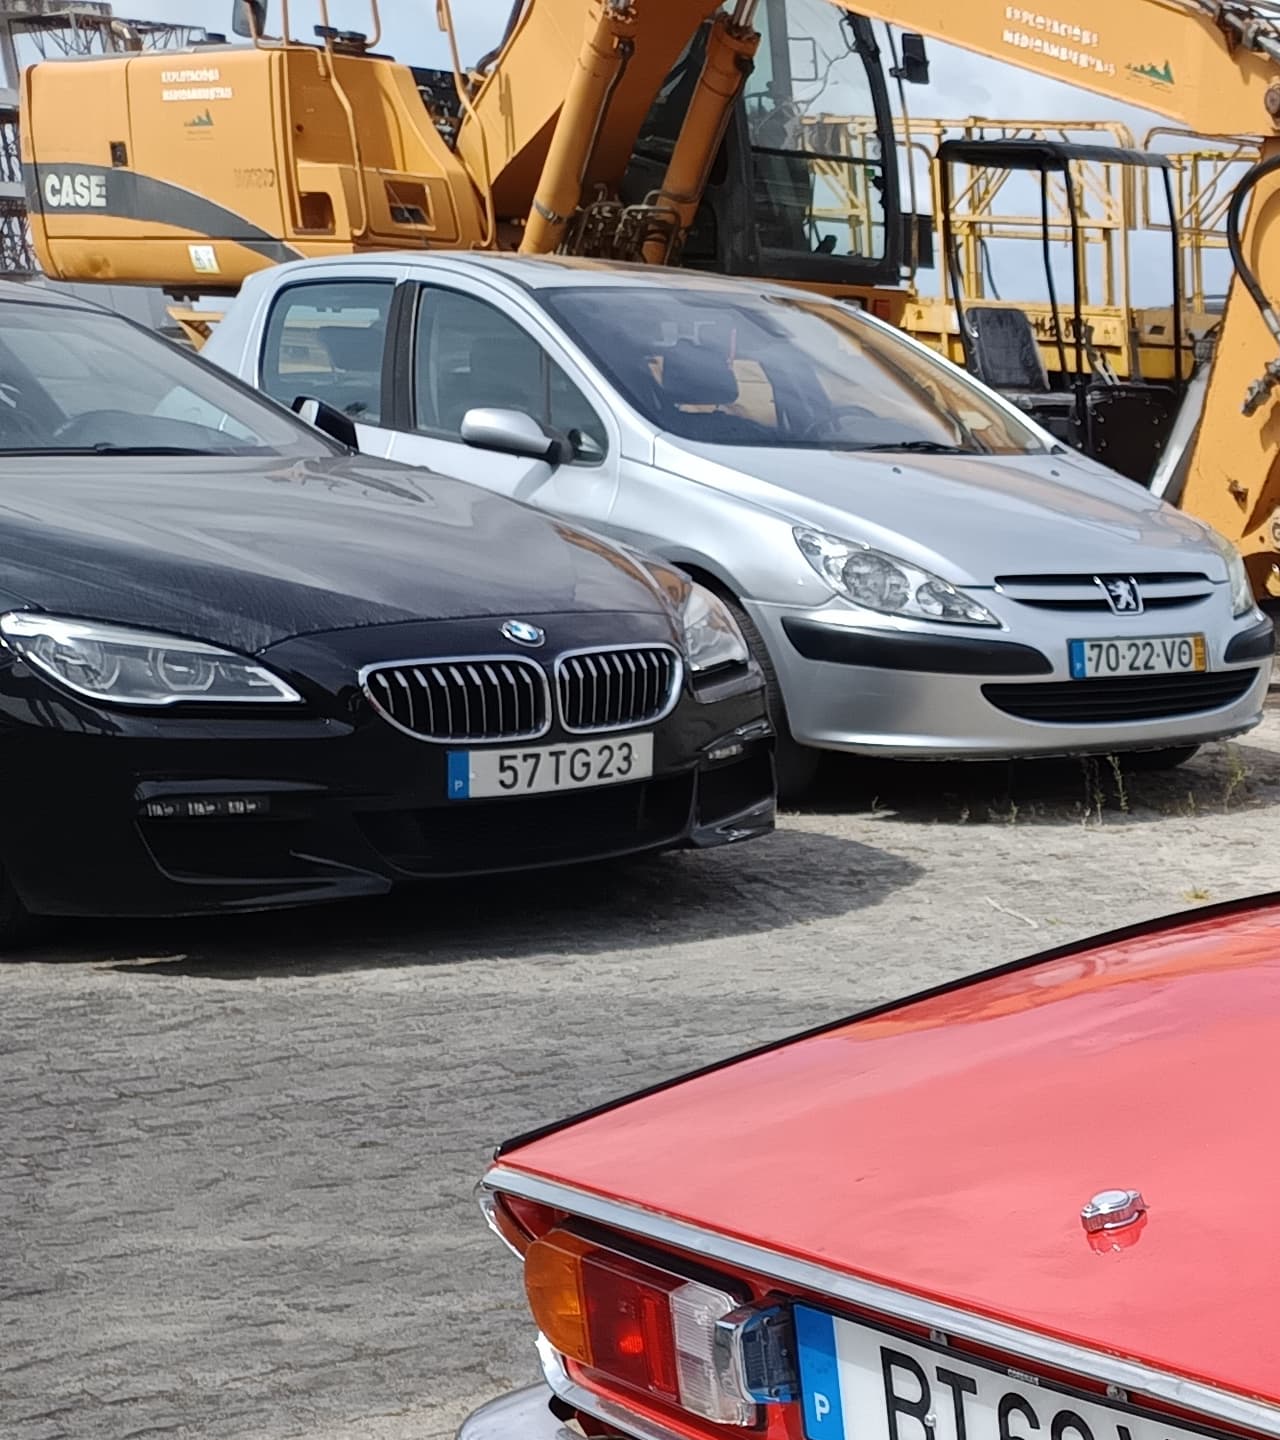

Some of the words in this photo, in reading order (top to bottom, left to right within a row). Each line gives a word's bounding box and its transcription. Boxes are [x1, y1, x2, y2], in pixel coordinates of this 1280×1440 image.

[44, 174, 107, 207] CASE
[454, 780, 464, 792] P
[813, 1391, 831, 1422] P
